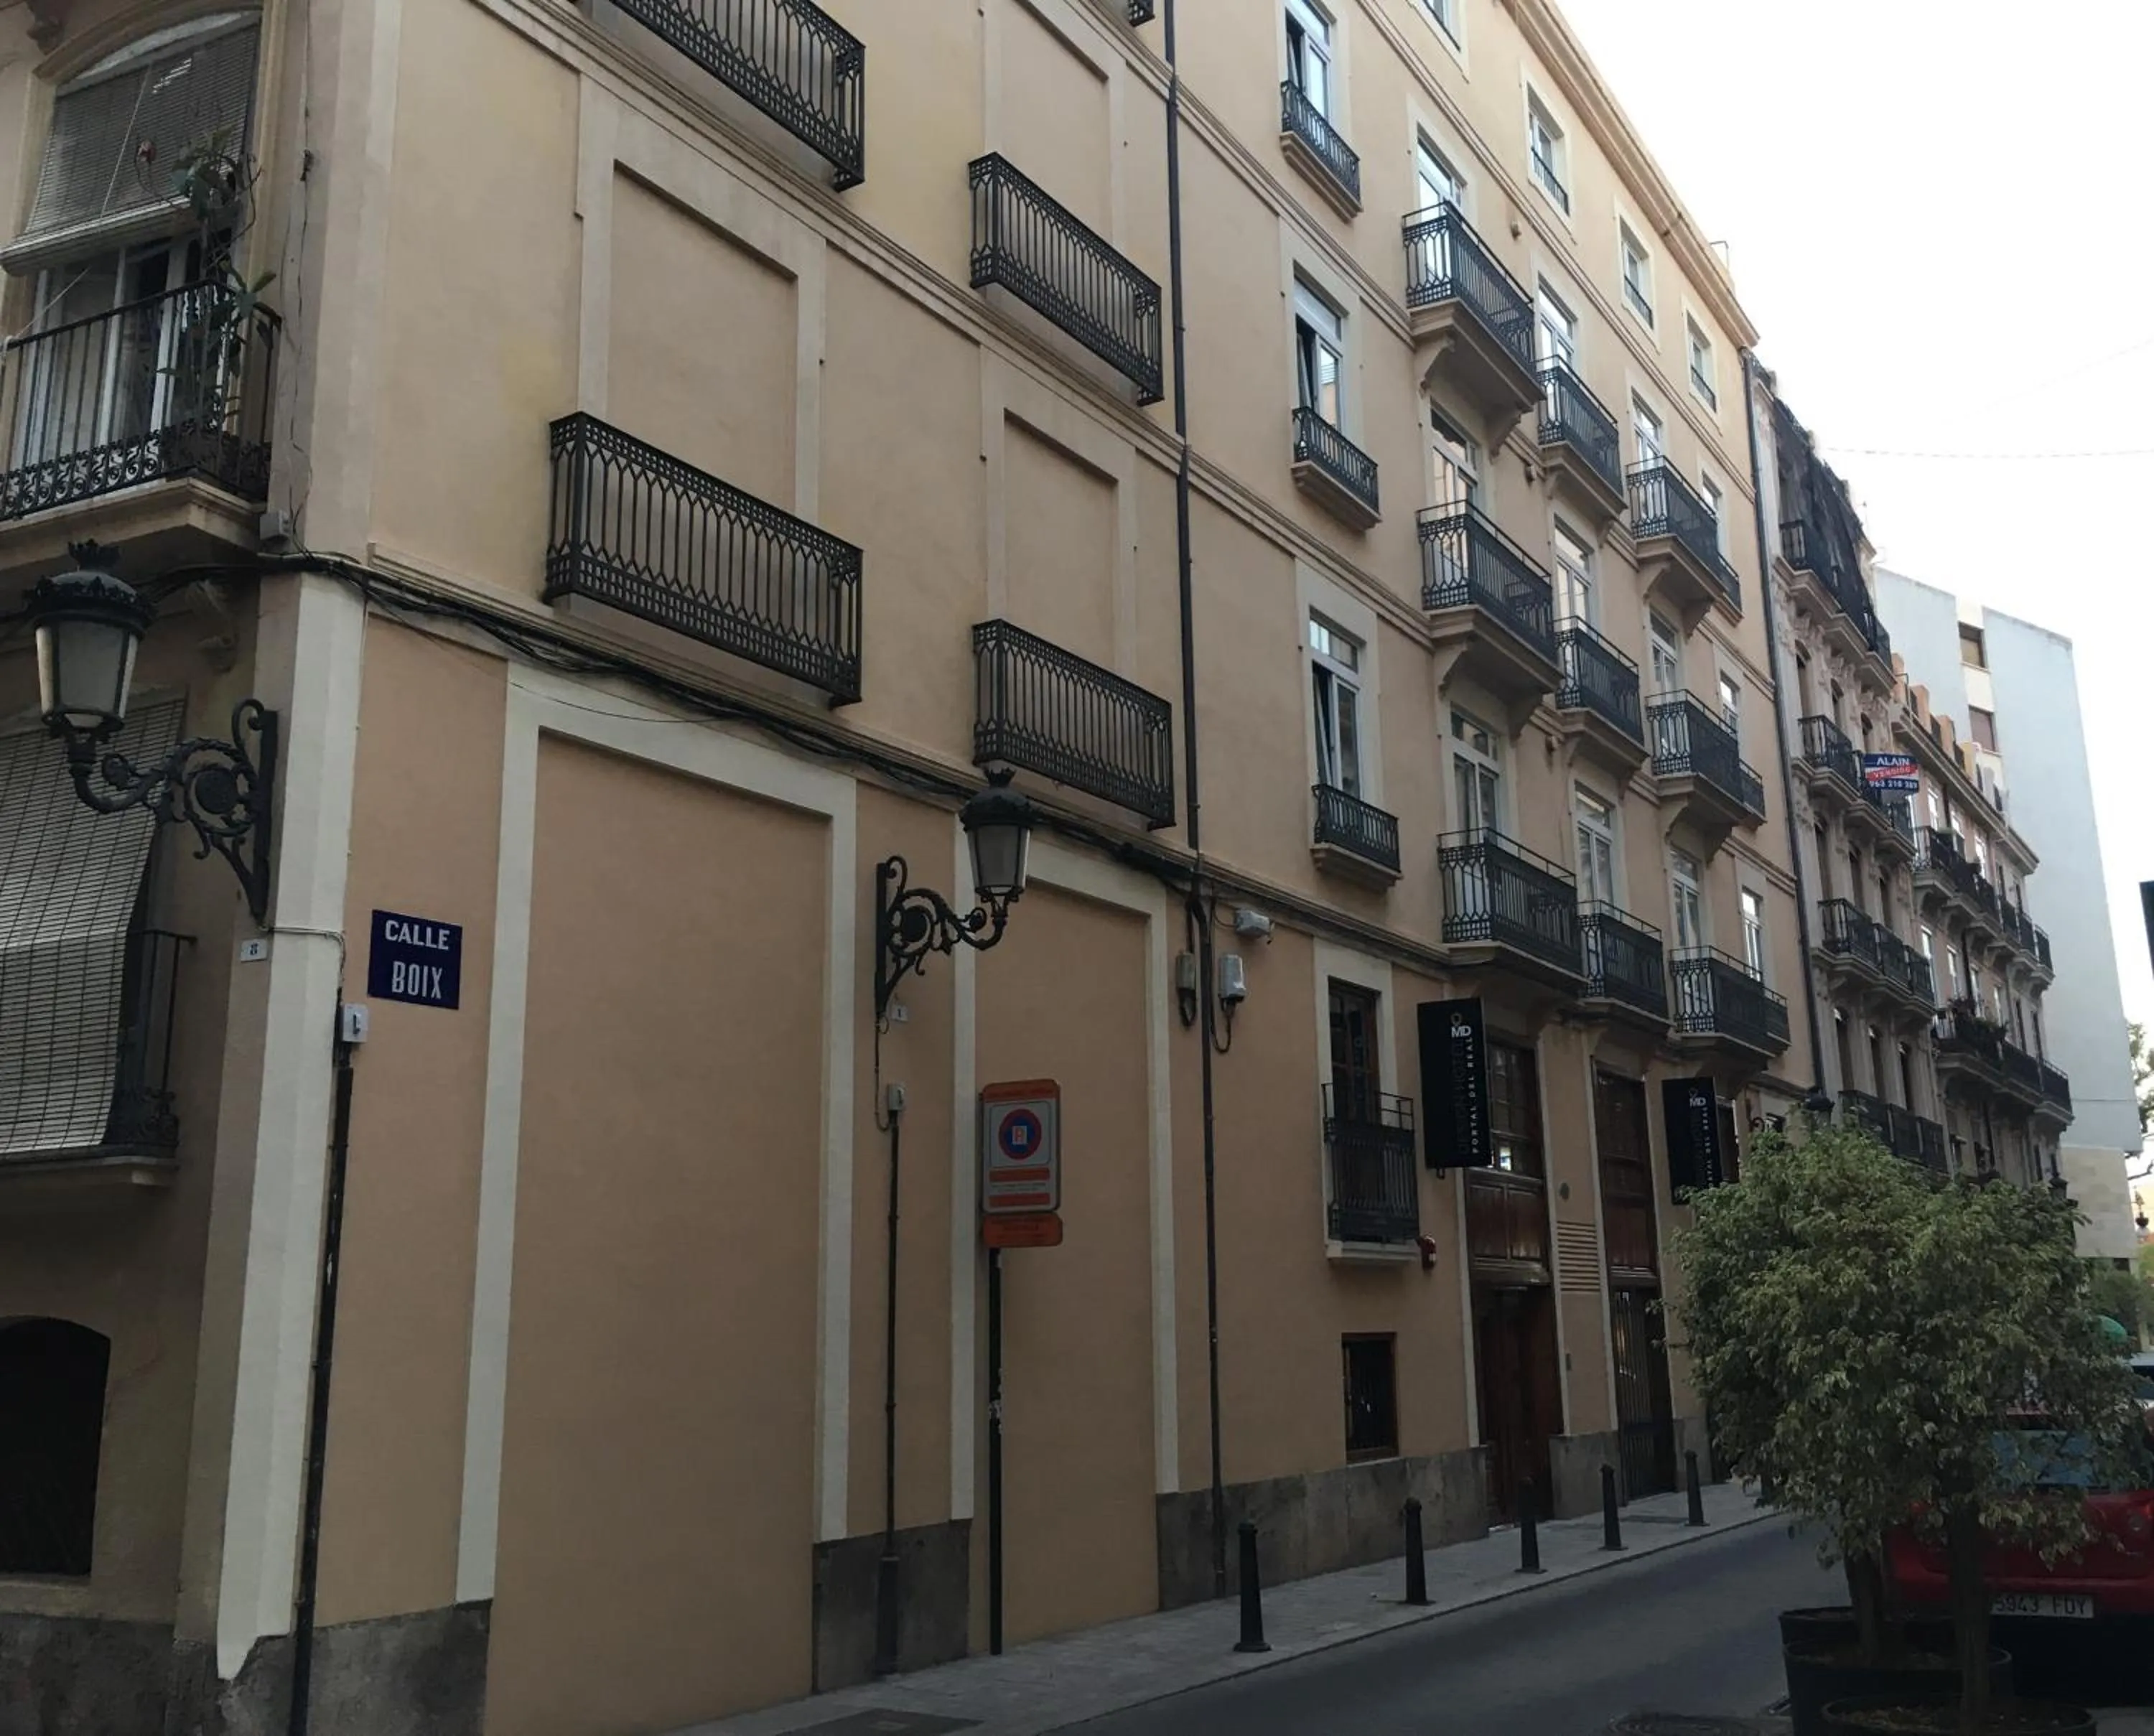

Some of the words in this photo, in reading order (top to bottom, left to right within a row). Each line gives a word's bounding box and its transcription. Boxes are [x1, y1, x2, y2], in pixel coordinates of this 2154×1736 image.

[1876, 756, 1910, 766] ALAIN
[385, 920, 450, 950] CALLE
[391, 960, 443, 999] BOIX
[1451, 1025, 1472, 1038] MD
[1468, 1075, 1476, 1098] DEL
[1470, 1106, 1478, 1154] PORTAL
